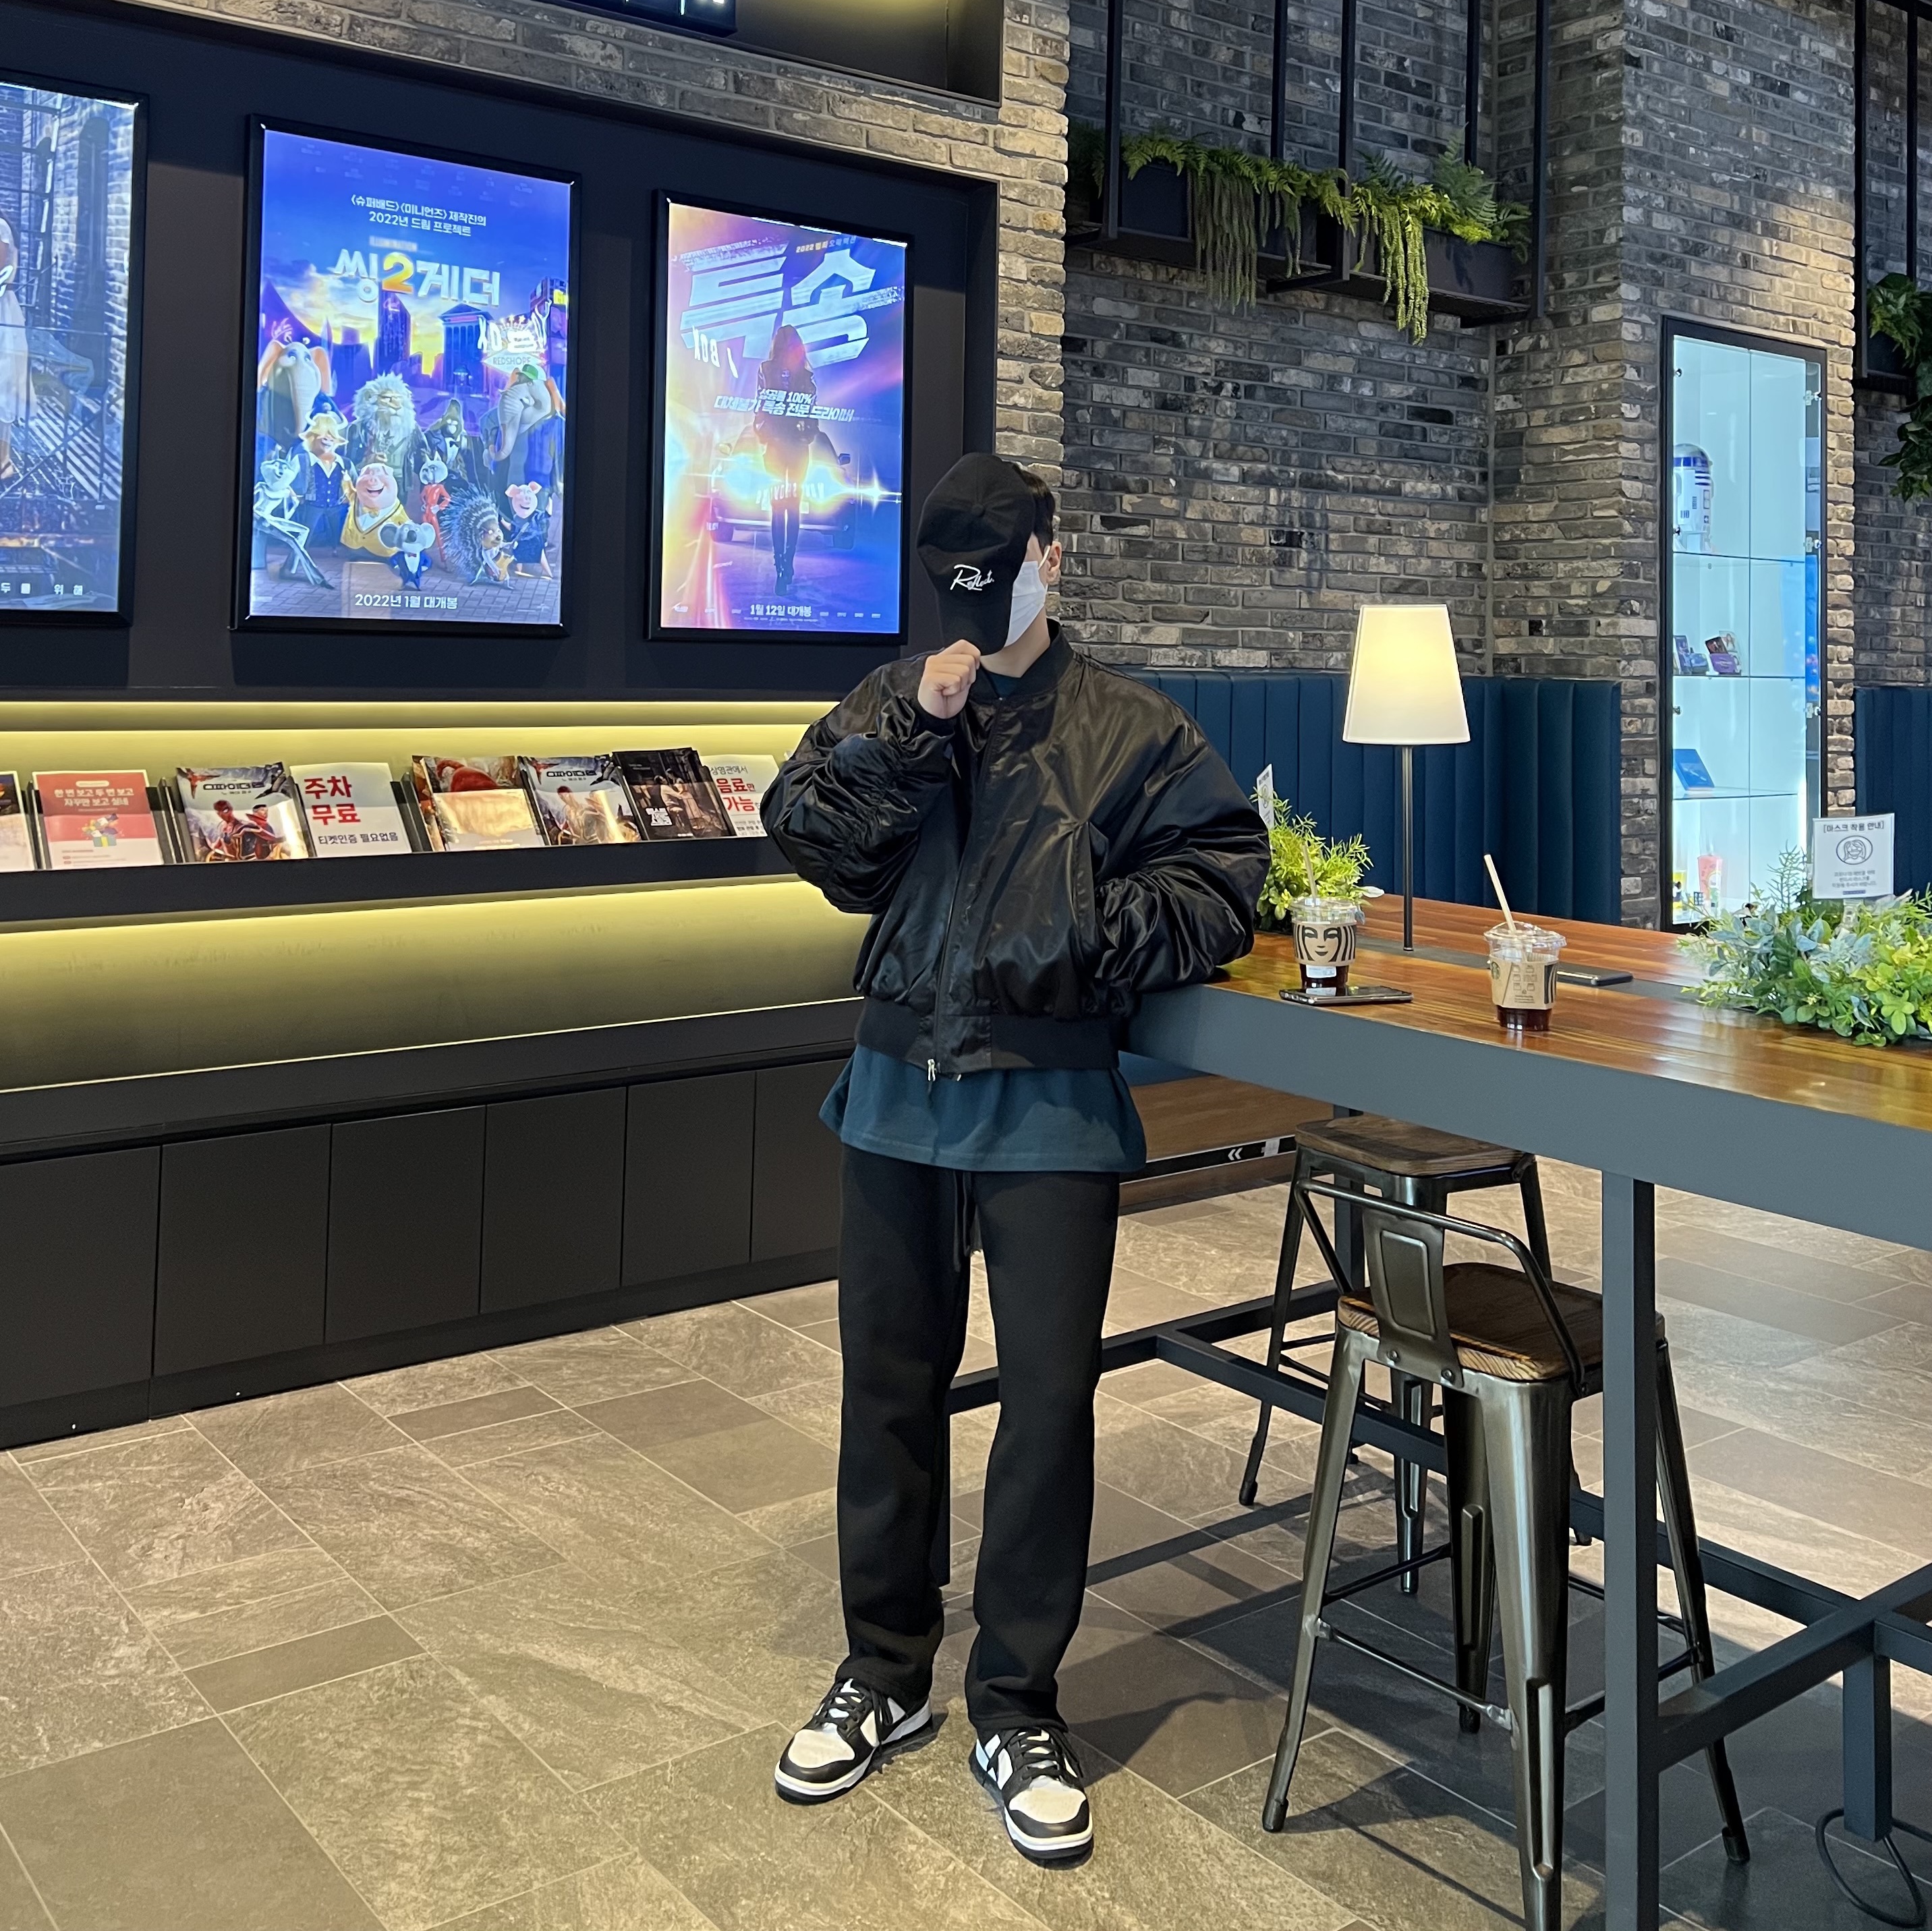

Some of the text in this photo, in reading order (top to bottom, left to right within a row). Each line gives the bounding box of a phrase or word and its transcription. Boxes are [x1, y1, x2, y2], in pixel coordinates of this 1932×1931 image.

[369, 211, 472, 237] 2022년 드림 프로젝트
[449, 210, 486, 226] 제작진의
[796, 243, 814, 253] 2022
[787, 391, 814, 405] 100%
[714, 395, 855, 422] 대체불가 특송 전문 드라이버
[355, 594, 458, 609] 2022년 1월 대개봉
[750, 604, 764, 616] 1월
[766, 604, 786, 616] 12일
[787, 605, 812, 617] 대개봉
[304, 776, 353, 799] 주차
[312, 803, 362, 826] 무료
[318, 832, 399, 844] 티켓인증 필요없음
